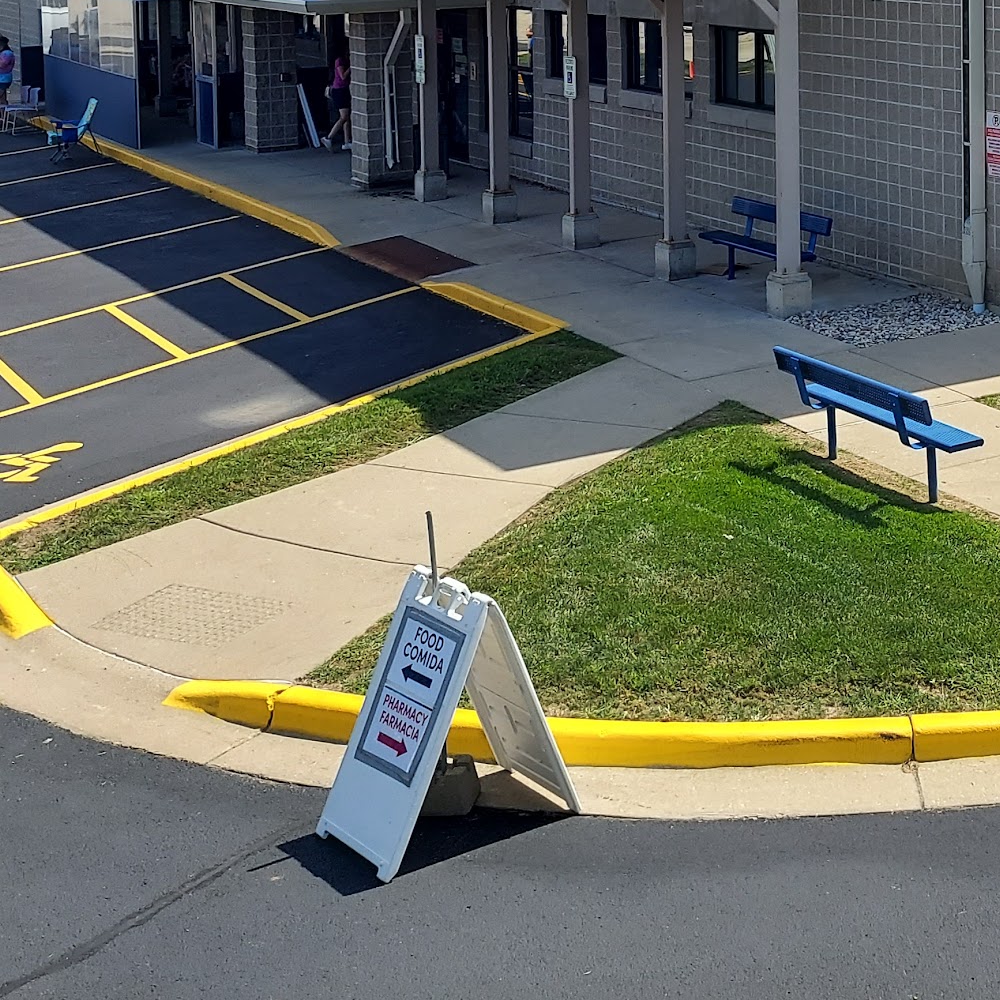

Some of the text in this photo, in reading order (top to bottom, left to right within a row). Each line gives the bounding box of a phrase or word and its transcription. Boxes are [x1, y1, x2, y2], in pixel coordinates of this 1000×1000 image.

[415, 626, 444, 651] FOOD
[403, 643, 444, 675] COMIDA
[382, 693, 429, 726] PHARMACY
[379, 710, 421, 743] FARMACIA
